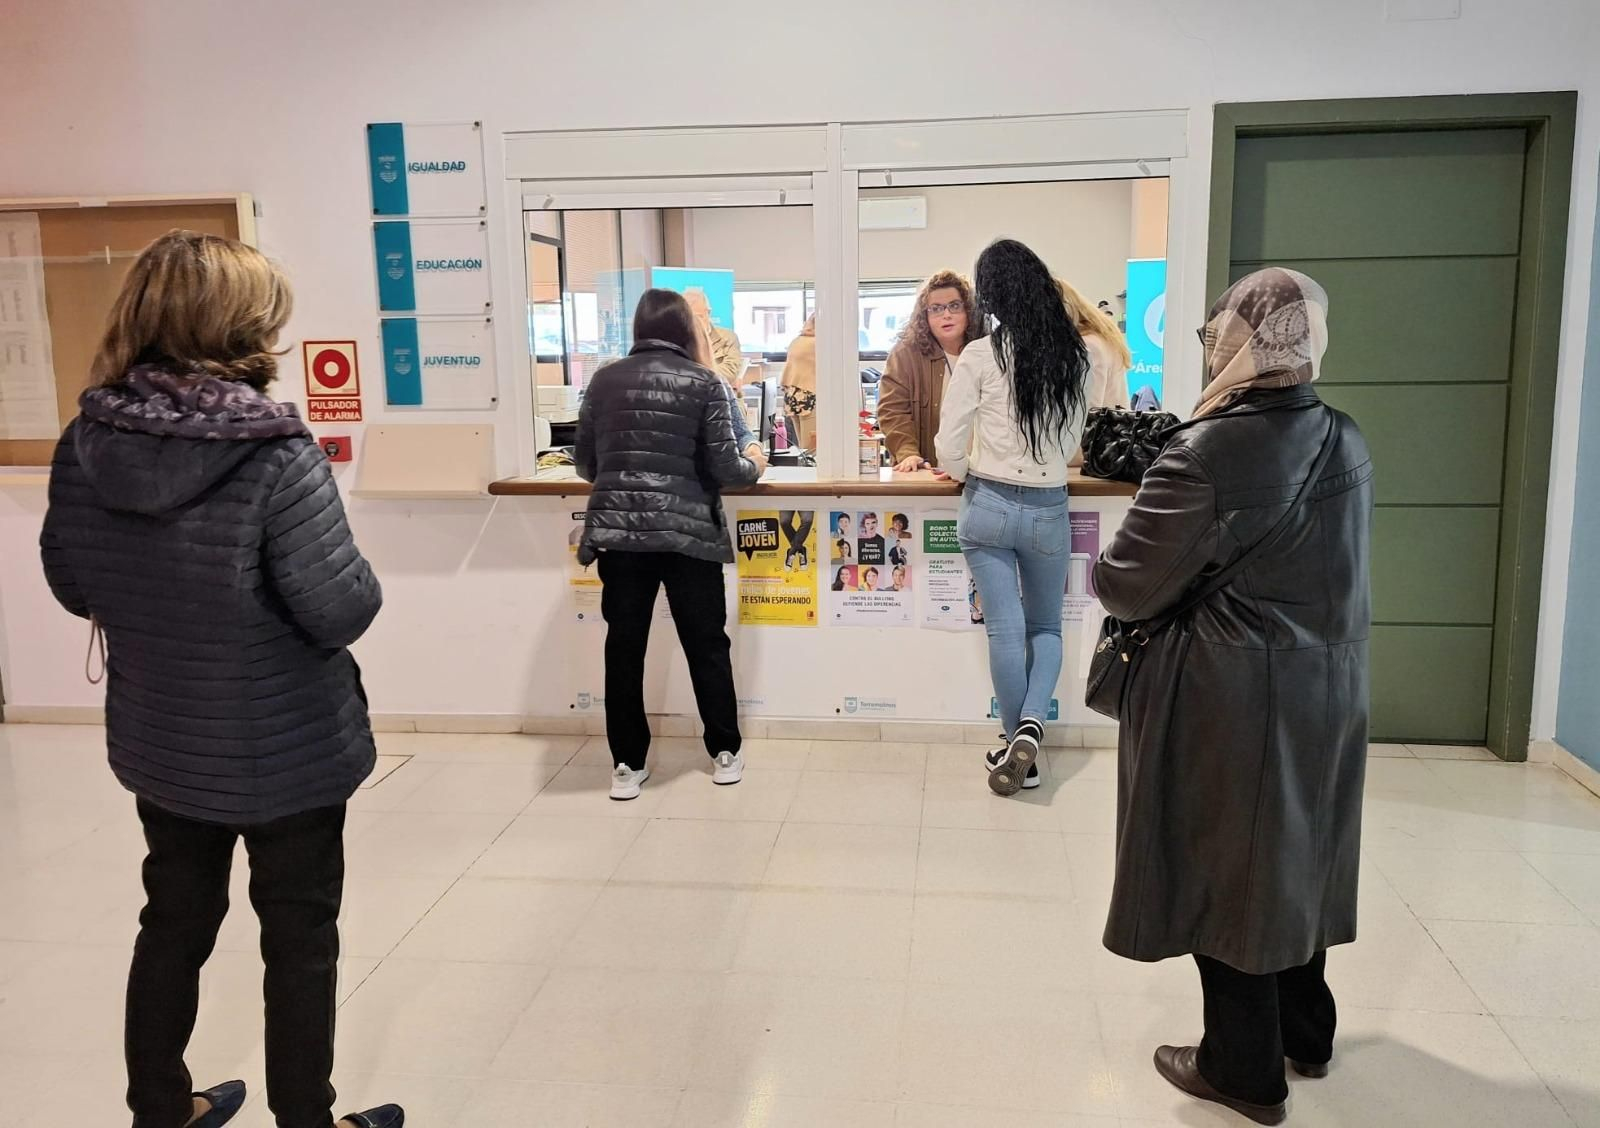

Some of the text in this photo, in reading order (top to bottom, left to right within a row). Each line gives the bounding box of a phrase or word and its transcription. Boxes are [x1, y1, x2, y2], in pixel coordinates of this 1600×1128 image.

[408, 161, 466, 172] IGUALDAD
[416, 257, 482, 270] EDUCACIÓN
[423, 355, 481, 366] JUVENTUD
[311, 401, 359, 410] PULSADOR
[310, 411, 361, 421] DE ALARMA
[738, 520, 767, 533] CARNÉ
[740, 533, 776, 548] JOVEN
[741, 595, 749, 604] TE
[772, 596, 811, 605] ESPERANDO
